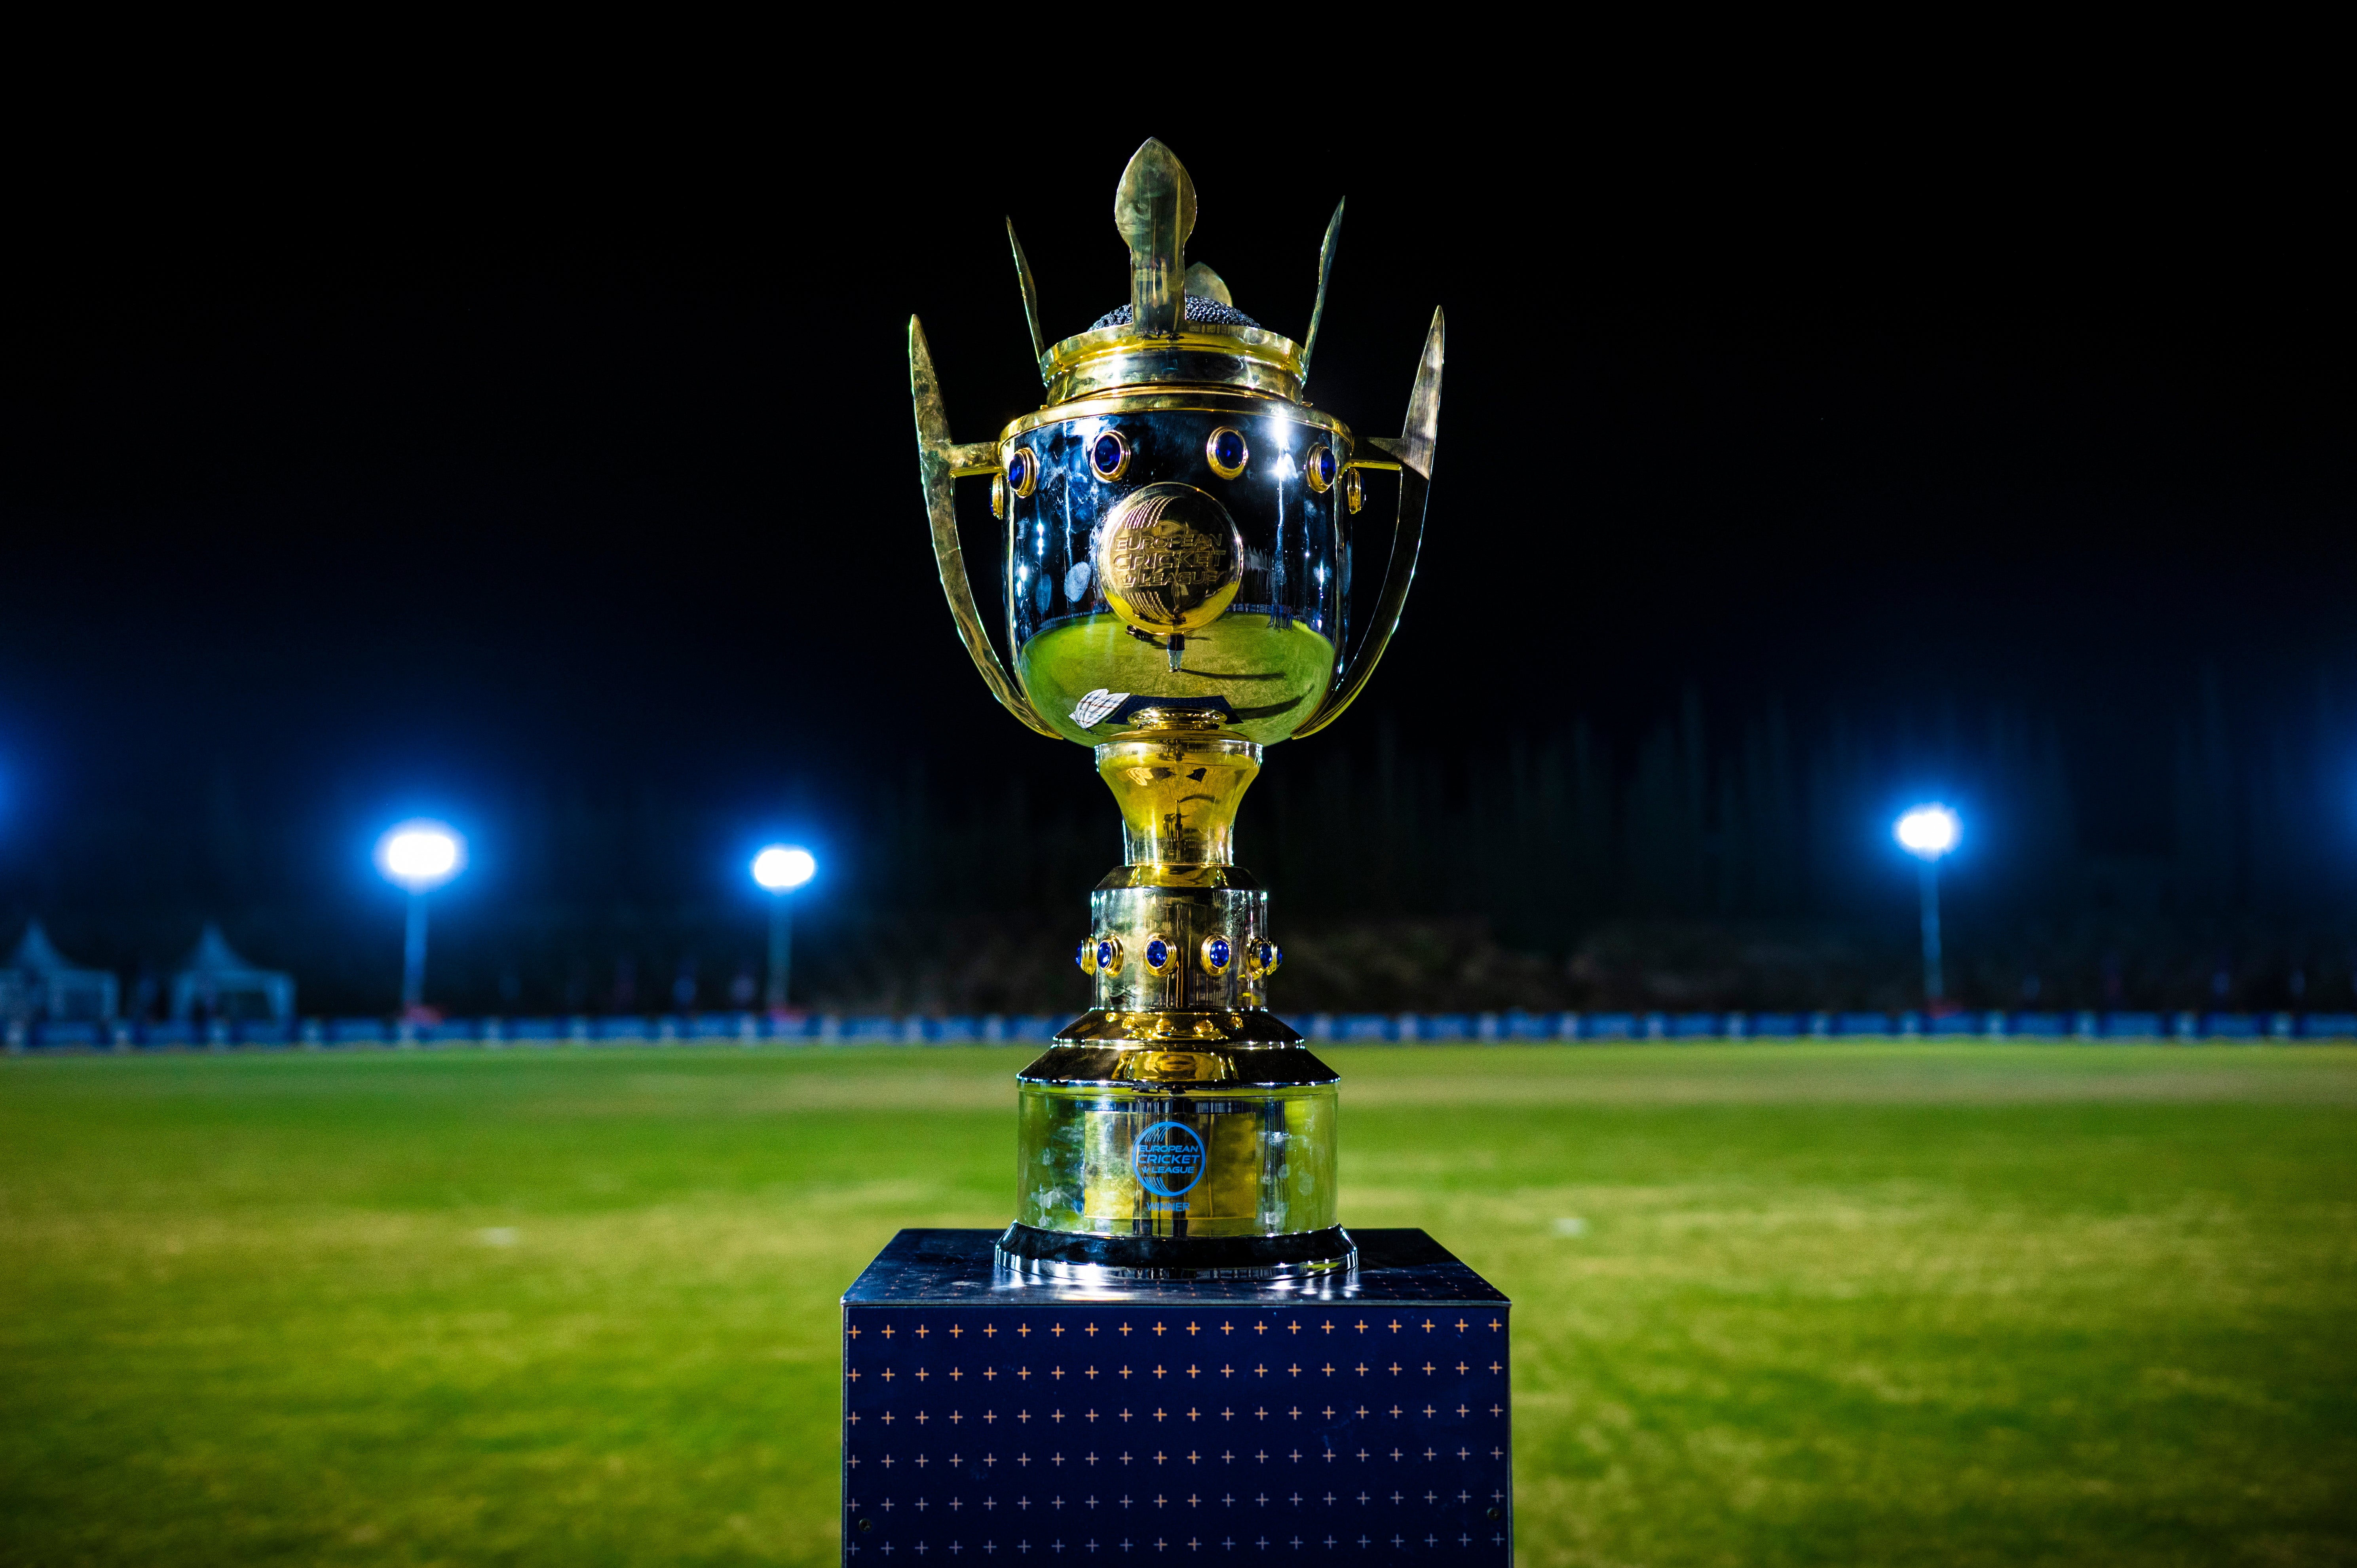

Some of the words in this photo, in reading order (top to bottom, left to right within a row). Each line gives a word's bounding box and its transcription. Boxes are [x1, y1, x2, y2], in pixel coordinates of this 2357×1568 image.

[1115, 533, 1222, 551] EUROPEAN
[1113, 550, 1227, 571] CRICKET
[1138, 571, 1218, 587] LEAGUE
[1138, 1155, 1200, 1164] CRICKET
[1147, 1202, 1190, 1211] WINNER
